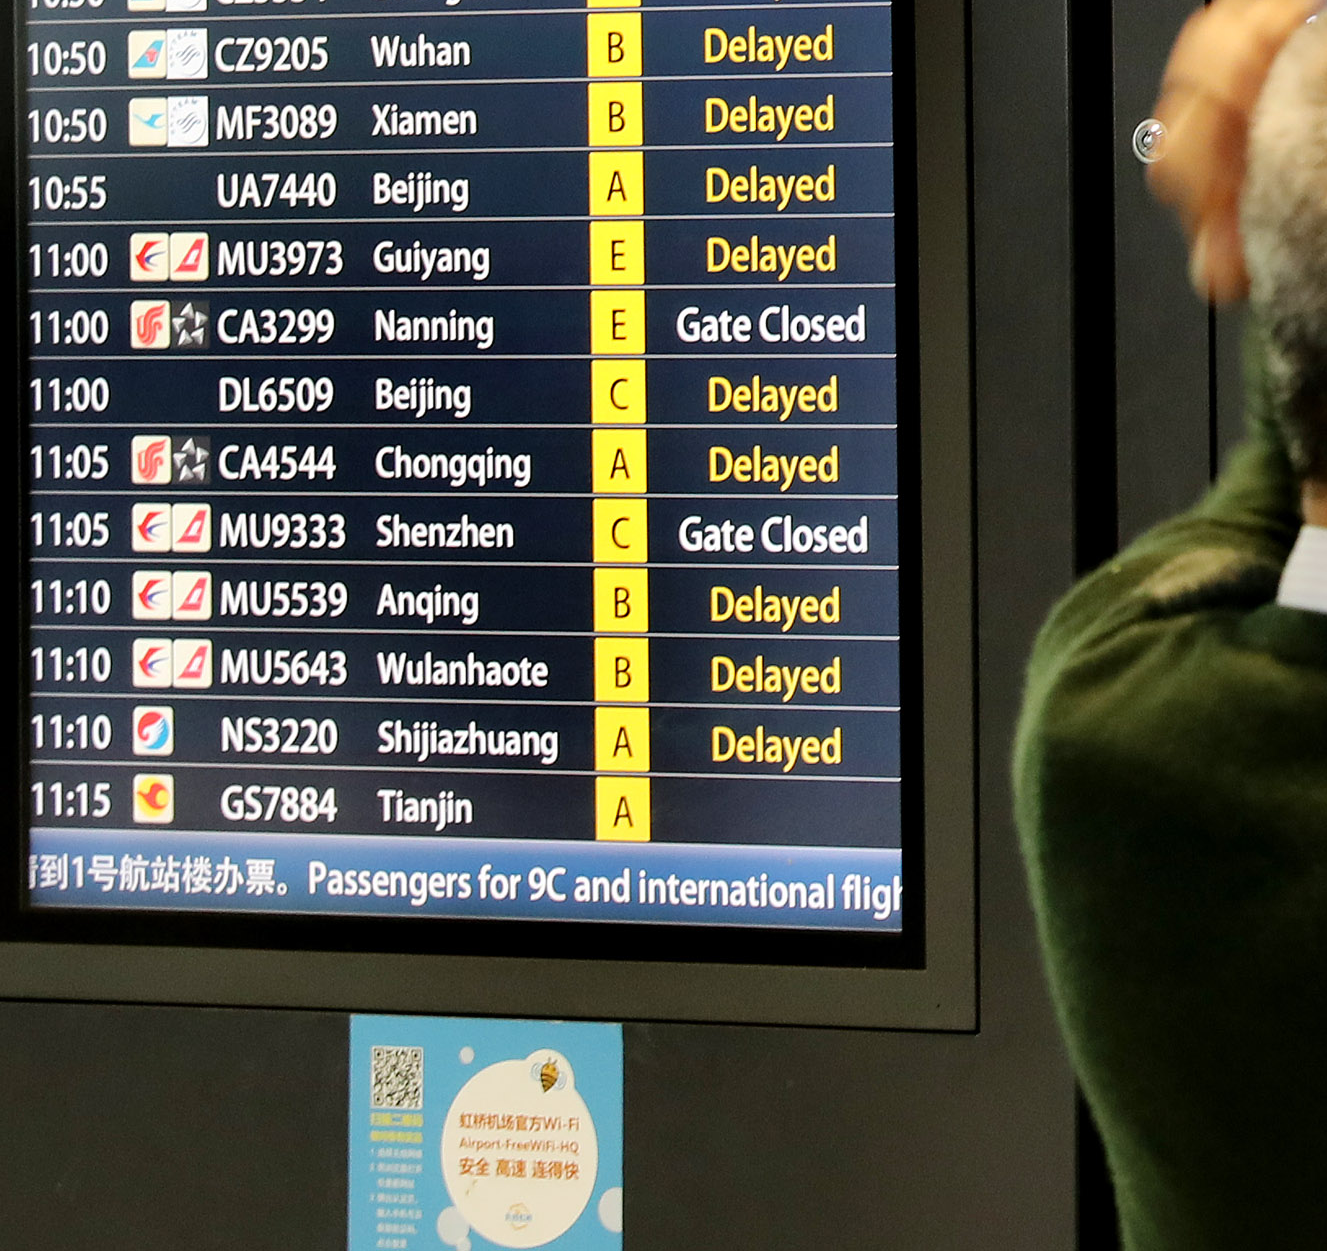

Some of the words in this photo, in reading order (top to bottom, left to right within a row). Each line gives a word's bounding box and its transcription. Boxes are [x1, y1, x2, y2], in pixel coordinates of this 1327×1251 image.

[27, 40, 107, 76] 10:50
[214, 36, 329, 73] CZ9205
[370, 33, 471, 68] Wuhan
[607, 31, 625, 64] B
[704, 23, 834, 72] Delayed
[28, 175, 107, 210] 10:55
[217, 172, 337, 208] UA7440
[373, 171, 469, 213] Beijing
[606, 170, 627, 202] A
[705, 164, 835, 212] Delayed
[30, 444, 109, 480] 11:05
[218, 444, 337, 481] CA4544
[375, 444, 531, 488] Chongqing
[609, 447, 631, 480] A
[708, 445, 839, 493] Delayed
[31, 713, 112, 750] 11:10
[221, 716, 338, 755] NS3220
[377, 719, 559, 765] Shijiazhuang
[612, 726, 633, 758] A
[711, 725, 842, 773] Delayed
[307, 859, 473, 908] Passengers
[477, 863, 522, 900] for
[527, 866, 567, 902] 9C
[573, 867, 631, 904] and
[638, 869, 835, 910] international
[459, 1158, 490, 1176] 安全
[496, 1159, 527, 1179] 高速
